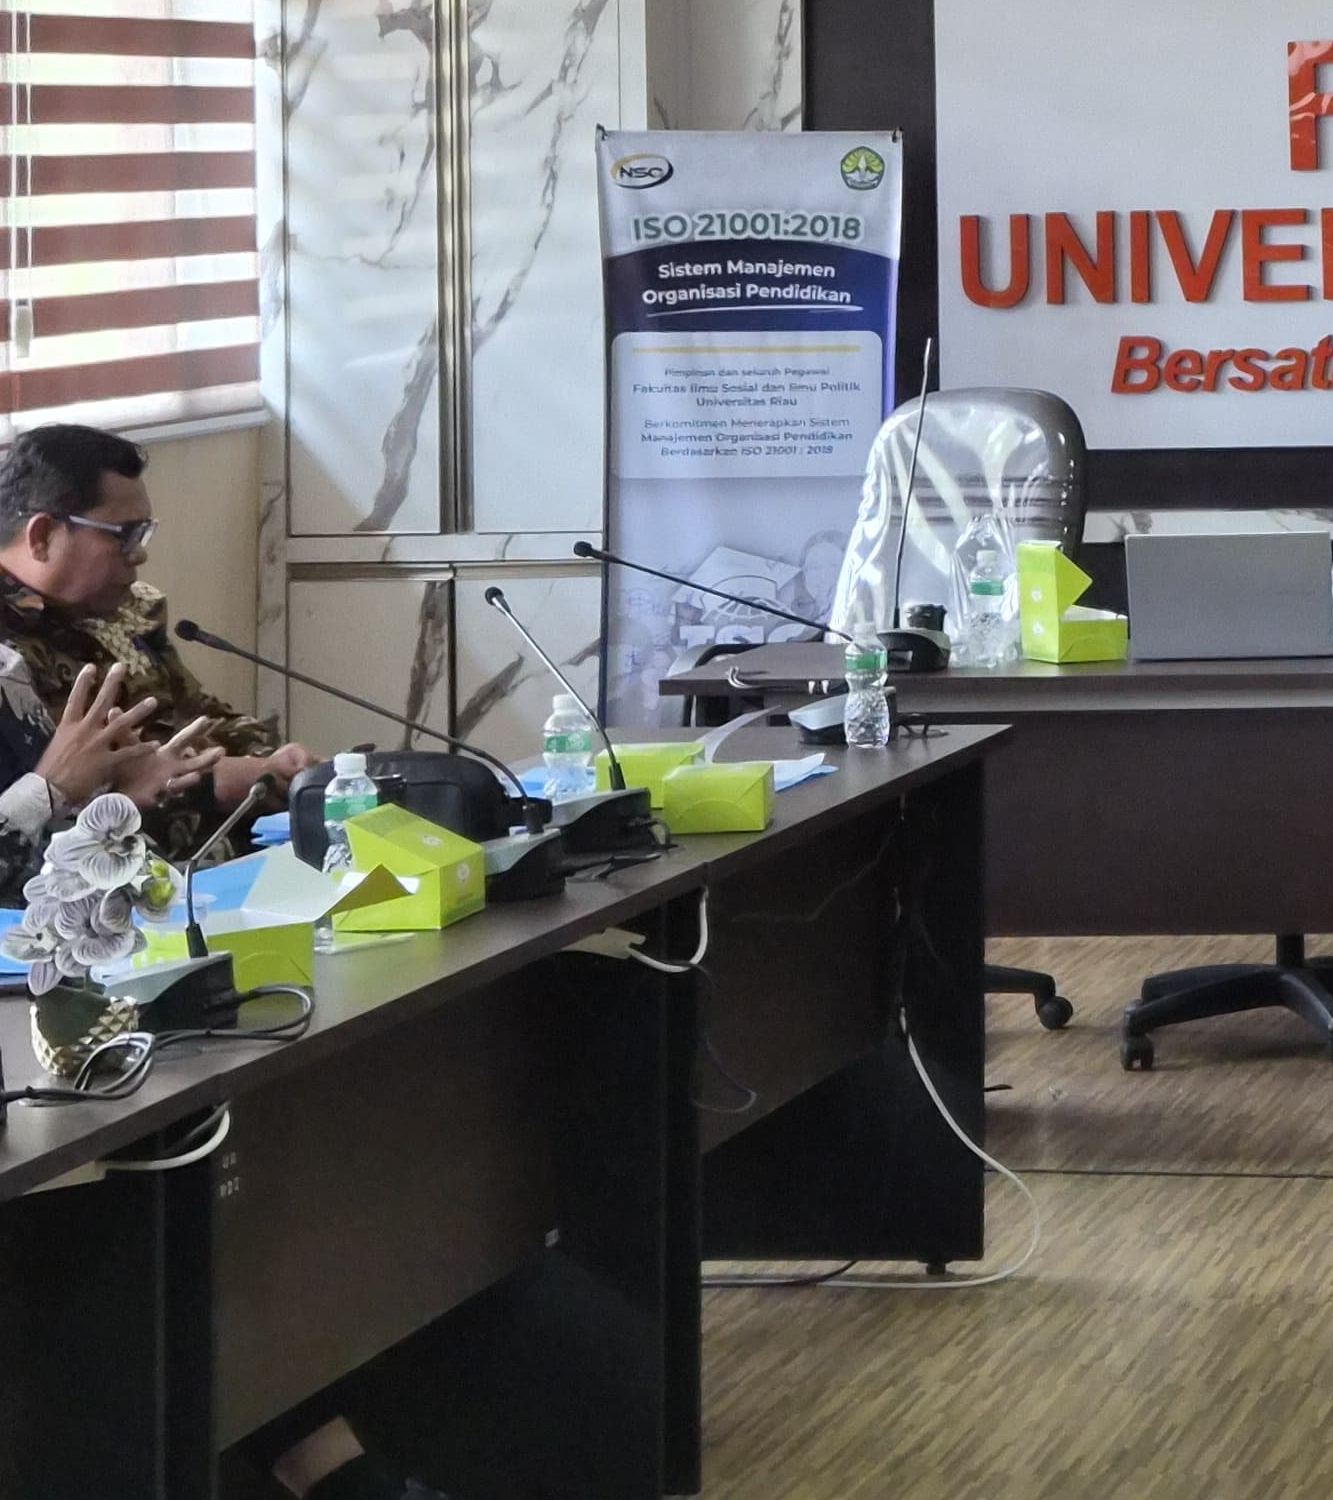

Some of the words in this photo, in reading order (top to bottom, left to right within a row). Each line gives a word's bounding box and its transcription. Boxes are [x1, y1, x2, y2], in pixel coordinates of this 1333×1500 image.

[633, 215, 689, 241] ISO
[698, 212, 862, 240] 21001:2018
[658, 262, 722, 279] Sistem
[727, 259, 836, 279] Manajemen
[642, 282, 741, 305] Organisasi
[746, 283, 852, 304] Pendidikan
[721, 382, 759, 393] Sosial
[762, 383, 785, 393] dan
[820, 382, 862, 393] Politik
[696, 397, 767, 407] Universitas
[769, 396, 798, 407] Riau
[644, 419, 728, 429] Berkomitmen
[730, 418, 807, 430] Menerapkan
[809, 418, 850, 428] Sistem
[641, 433, 713, 444] Manajemen
[783, 431, 853, 442] Pendidikan
